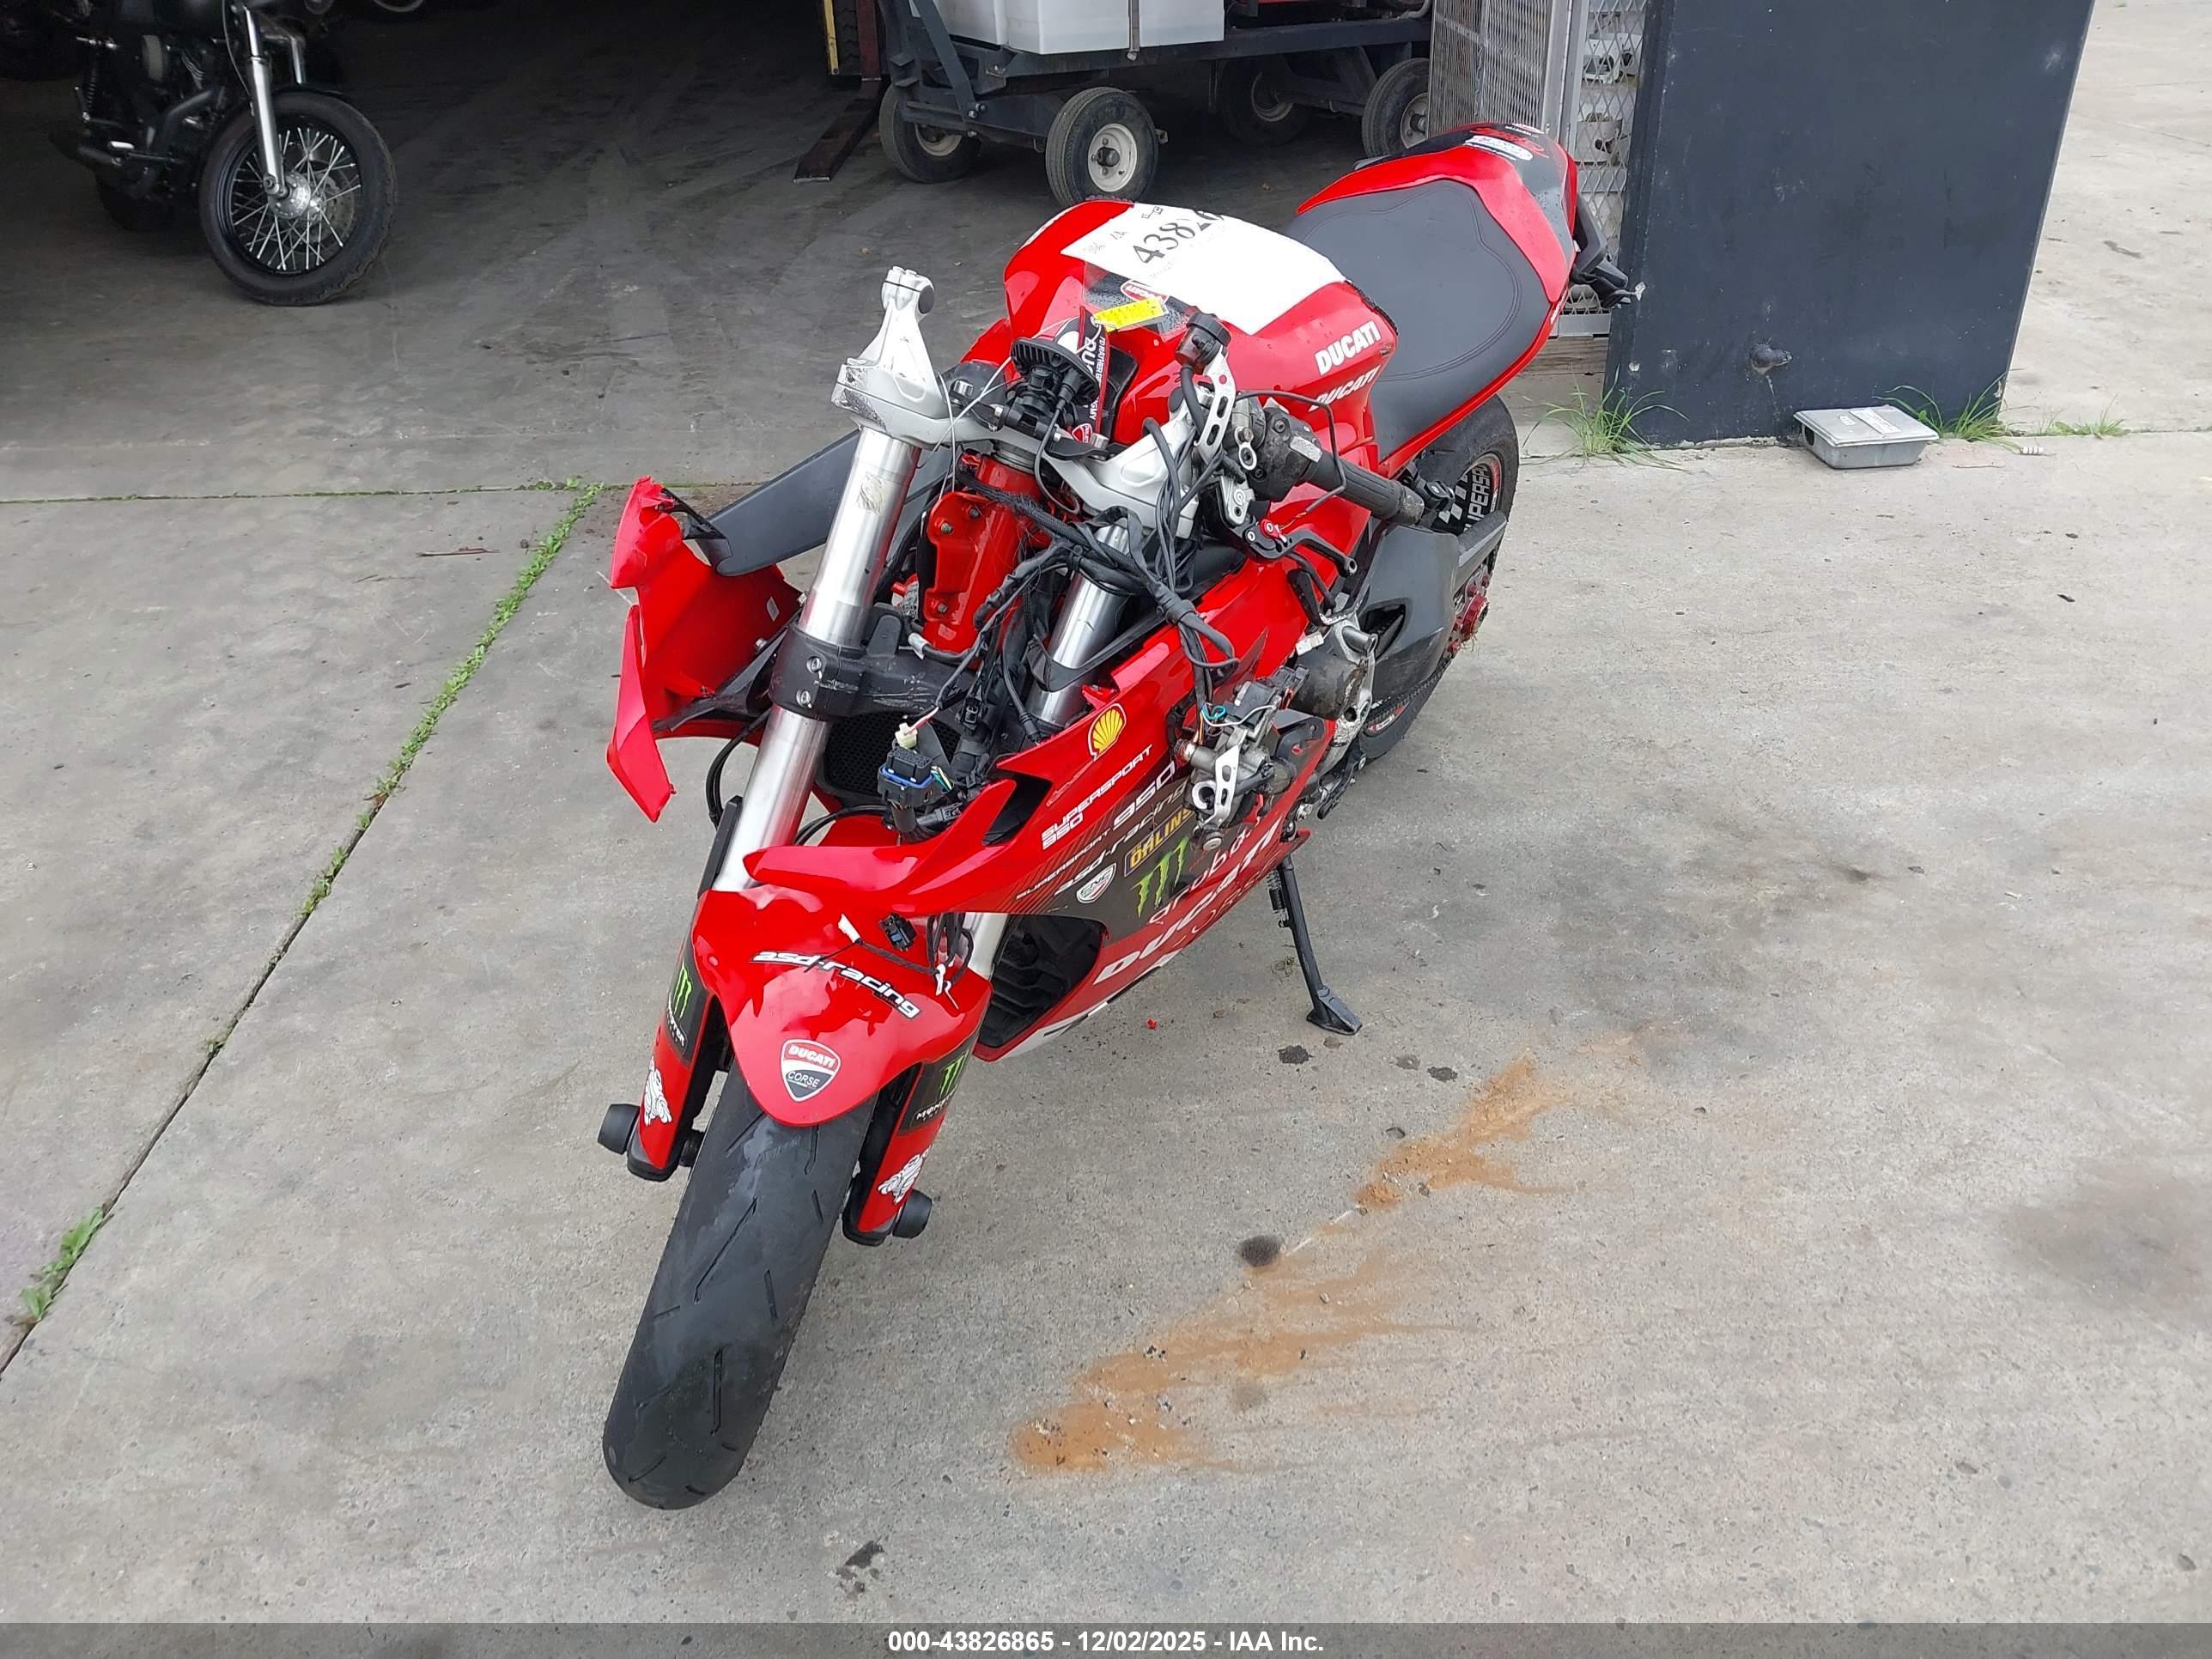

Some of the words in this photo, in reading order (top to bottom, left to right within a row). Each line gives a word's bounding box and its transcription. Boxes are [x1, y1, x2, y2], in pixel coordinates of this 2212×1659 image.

[1315, 320, 1382, 376] DUCATI
[1308, 365, 1381, 412] DUCATI
[1042, 744, 1152, 842] SUPERSPORT
[1017, 828, 1111, 900] SUPERSPORT
[1113, 761, 1175, 831] 950
[1042, 811, 1084, 850] 950
[1093, 816, 1281, 985] DUCATI
[753, 951, 921, 1019] asd-racing
[787, 1071, 820, 1088] CORSE
[788, 1044, 836, 1067] DUCATI
